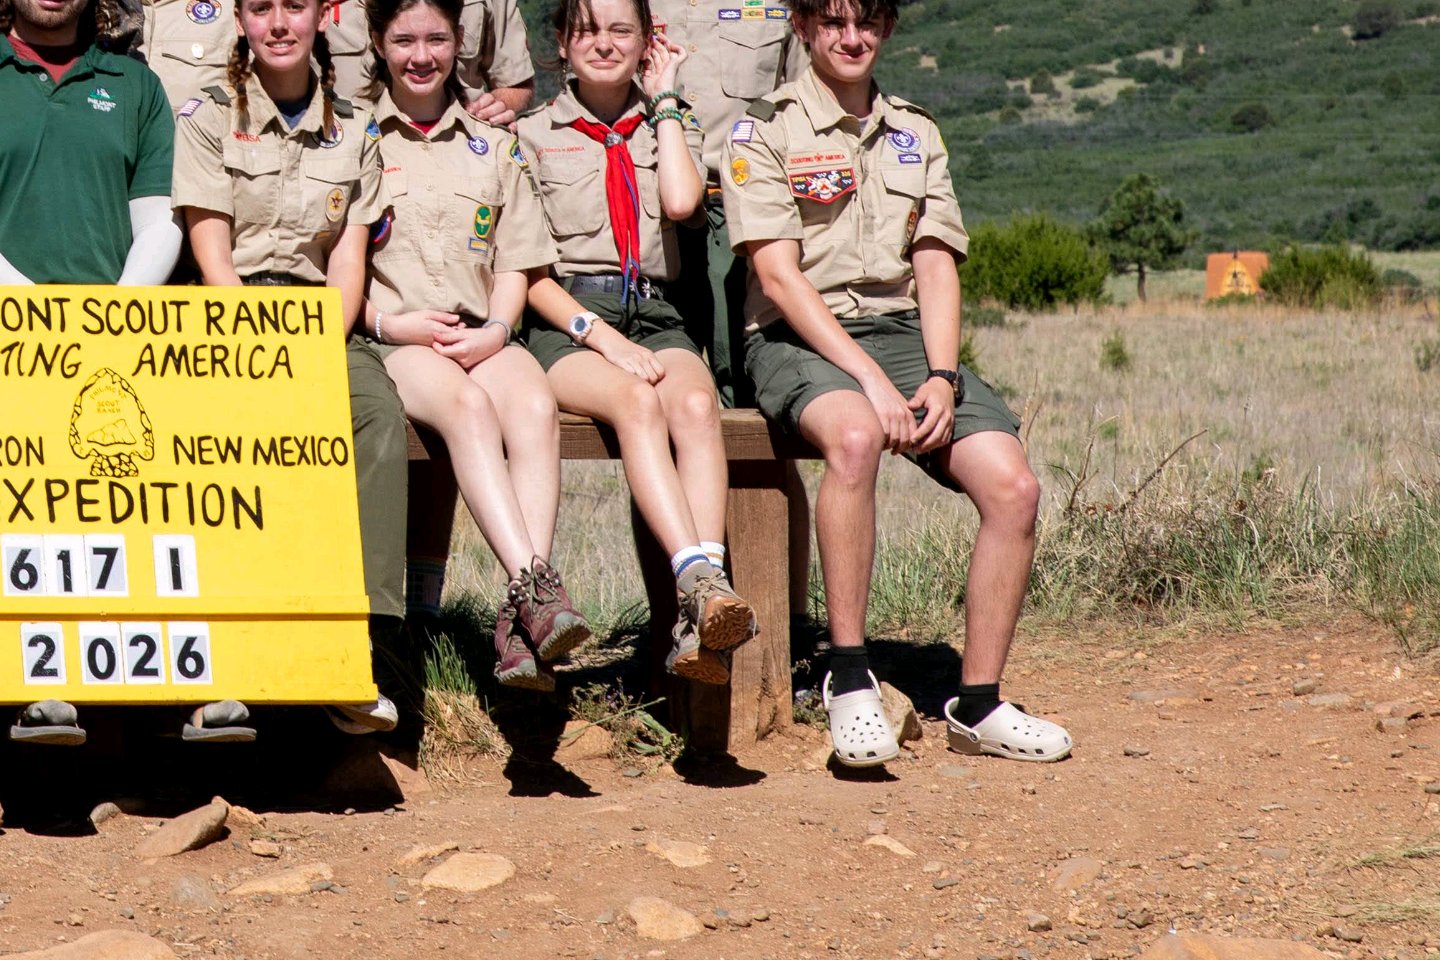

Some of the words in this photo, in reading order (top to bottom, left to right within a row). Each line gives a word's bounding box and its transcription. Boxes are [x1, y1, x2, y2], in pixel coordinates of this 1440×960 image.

[87, 97, 117, 108] PHILMONT
[82, 297, 190, 336] SCOUT
[205, 299, 324, 336] RANCH
[132, 342, 293, 380] AMERICA
[173, 434, 242, 465] NEW
[253, 436, 349, 467] MEXICO
[10, 547, 119, 592] 617
[28, 634, 205, 680] 2026
